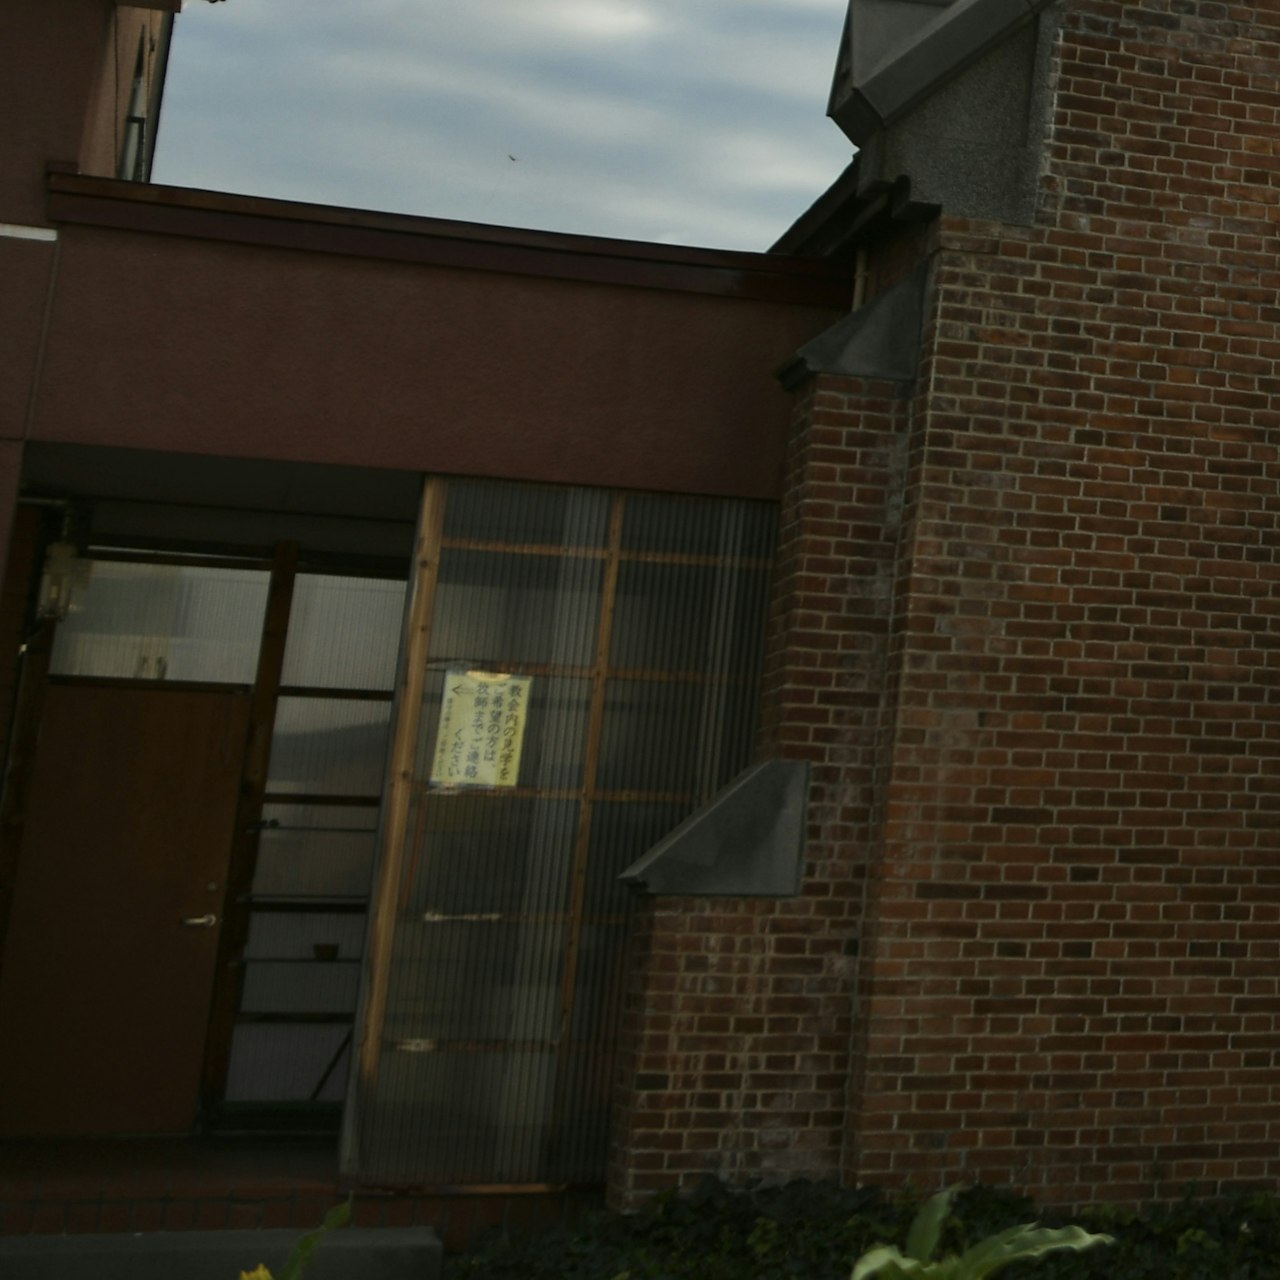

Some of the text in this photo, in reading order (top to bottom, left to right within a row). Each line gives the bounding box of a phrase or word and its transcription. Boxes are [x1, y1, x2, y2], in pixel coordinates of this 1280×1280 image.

[448, 728, 465, 777] ください
[500, 685, 522, 780] 教会内の見学を
